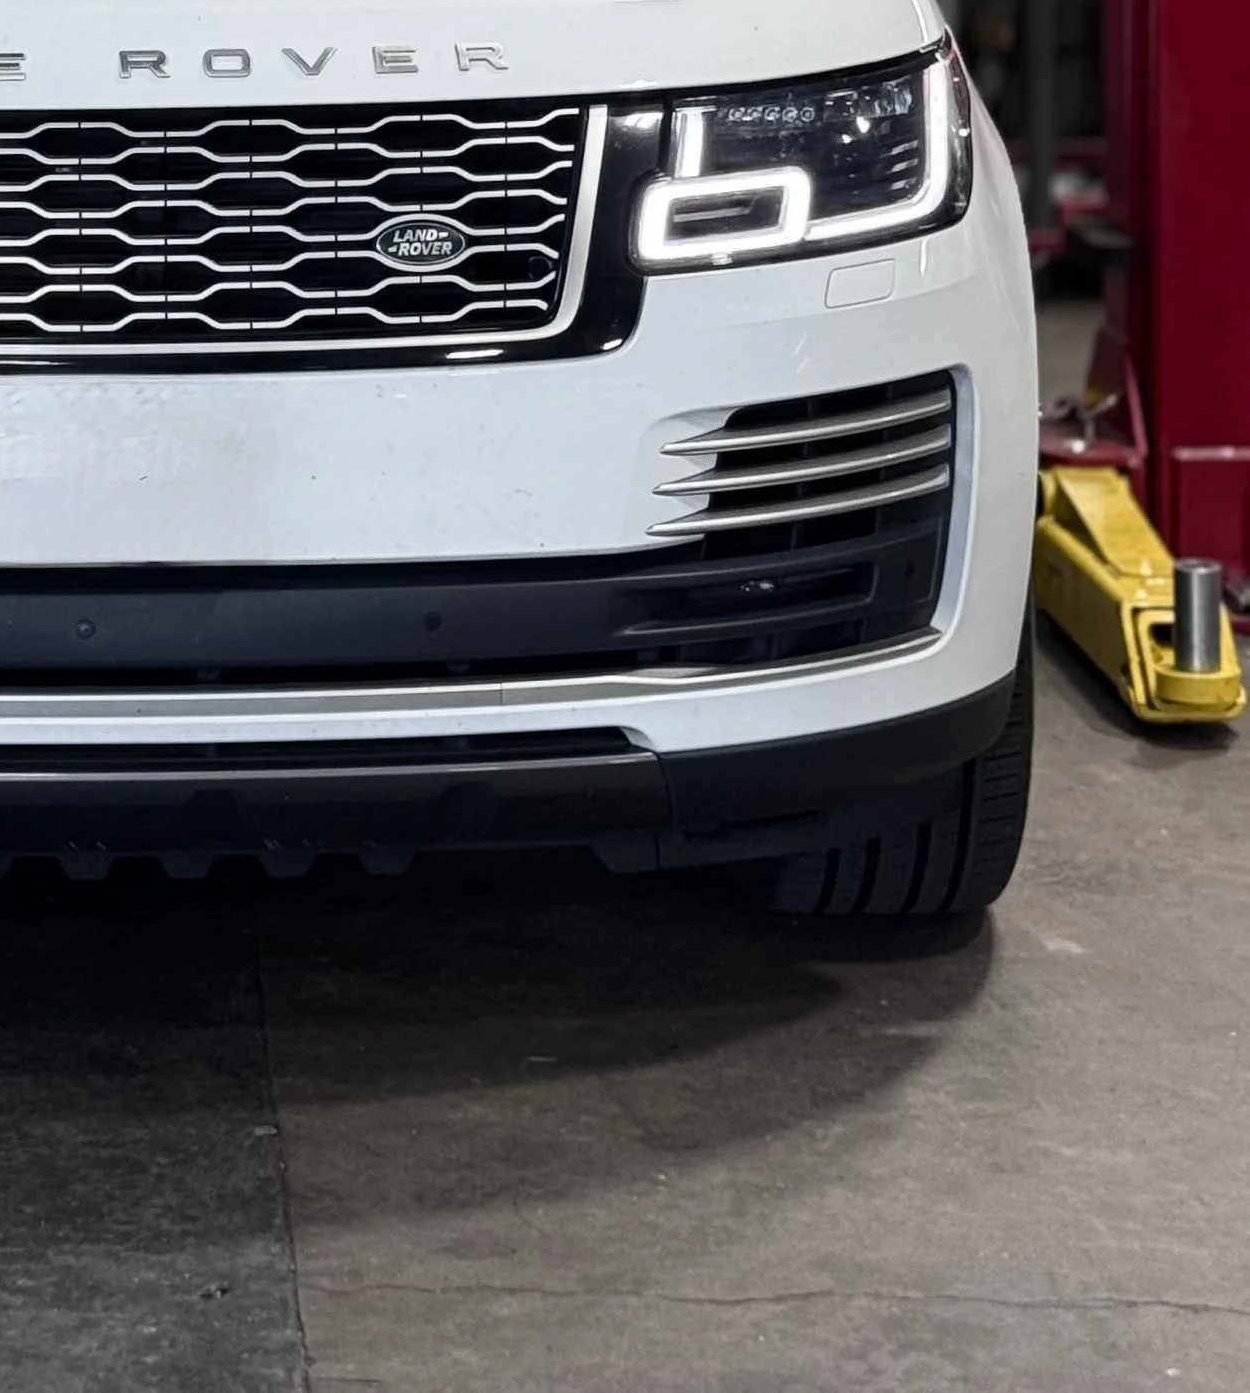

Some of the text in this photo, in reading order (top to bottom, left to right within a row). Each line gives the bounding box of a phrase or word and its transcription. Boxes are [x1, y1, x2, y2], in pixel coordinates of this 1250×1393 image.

[118, 42, 510, 80] ROVER
[392, 228, 438, 243] LAND
[398, 241, 453, 256] ROVER
